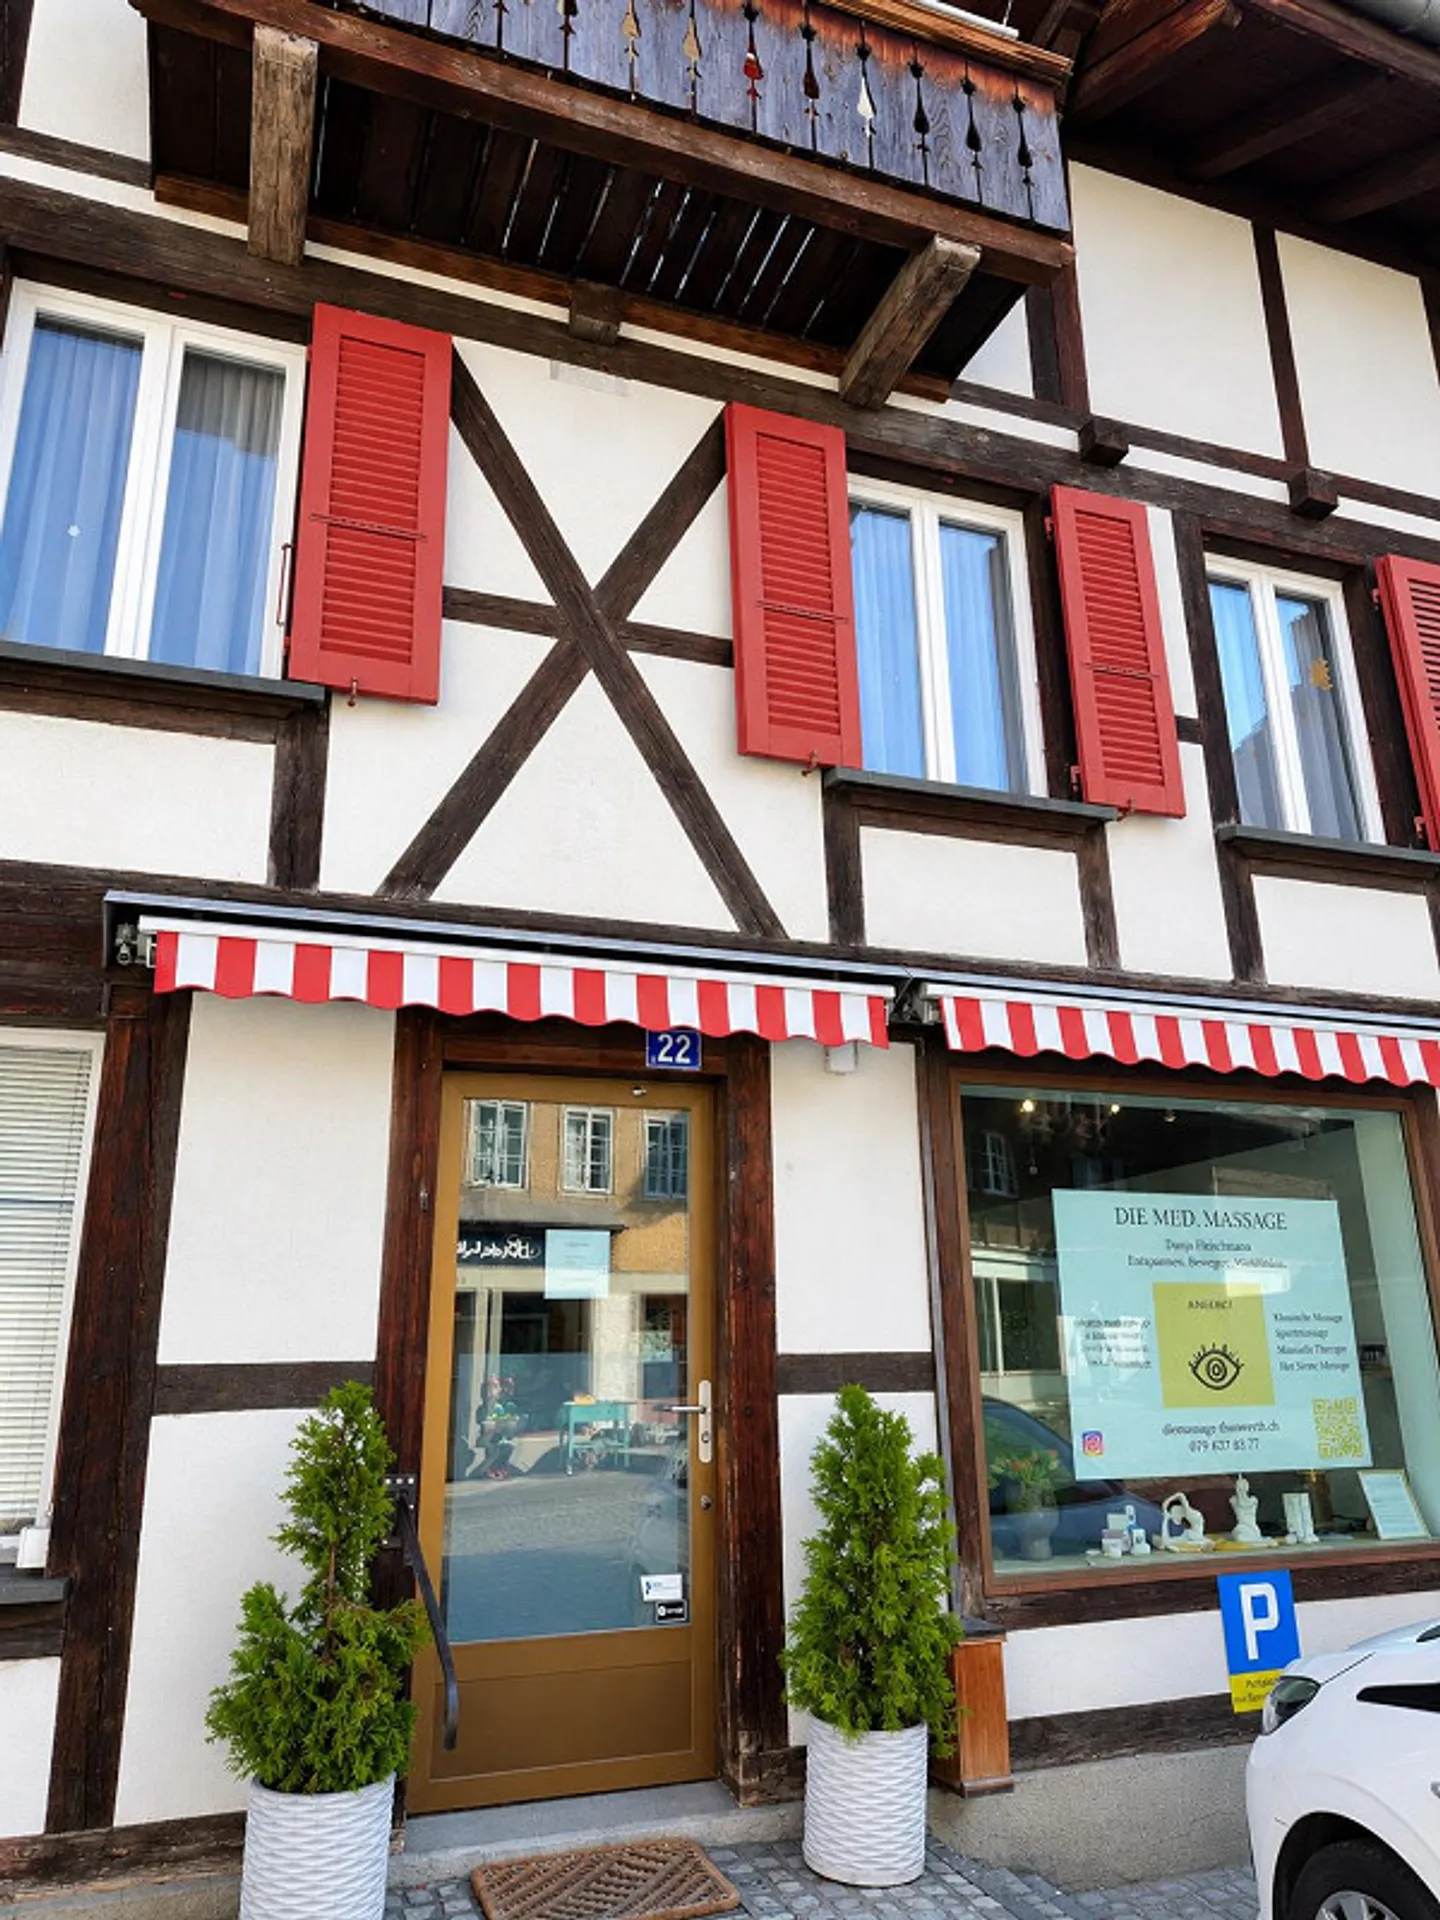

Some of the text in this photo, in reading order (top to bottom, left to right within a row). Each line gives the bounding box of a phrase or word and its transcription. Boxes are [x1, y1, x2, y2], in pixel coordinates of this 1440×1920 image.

[658, 1033, 691, 1064] 22
[1114, 1206, 1148, 1226] DIE
[1203, 1210, 1288, 1231] MASSAGE
[1239, 1582, 1280, 1661] P
